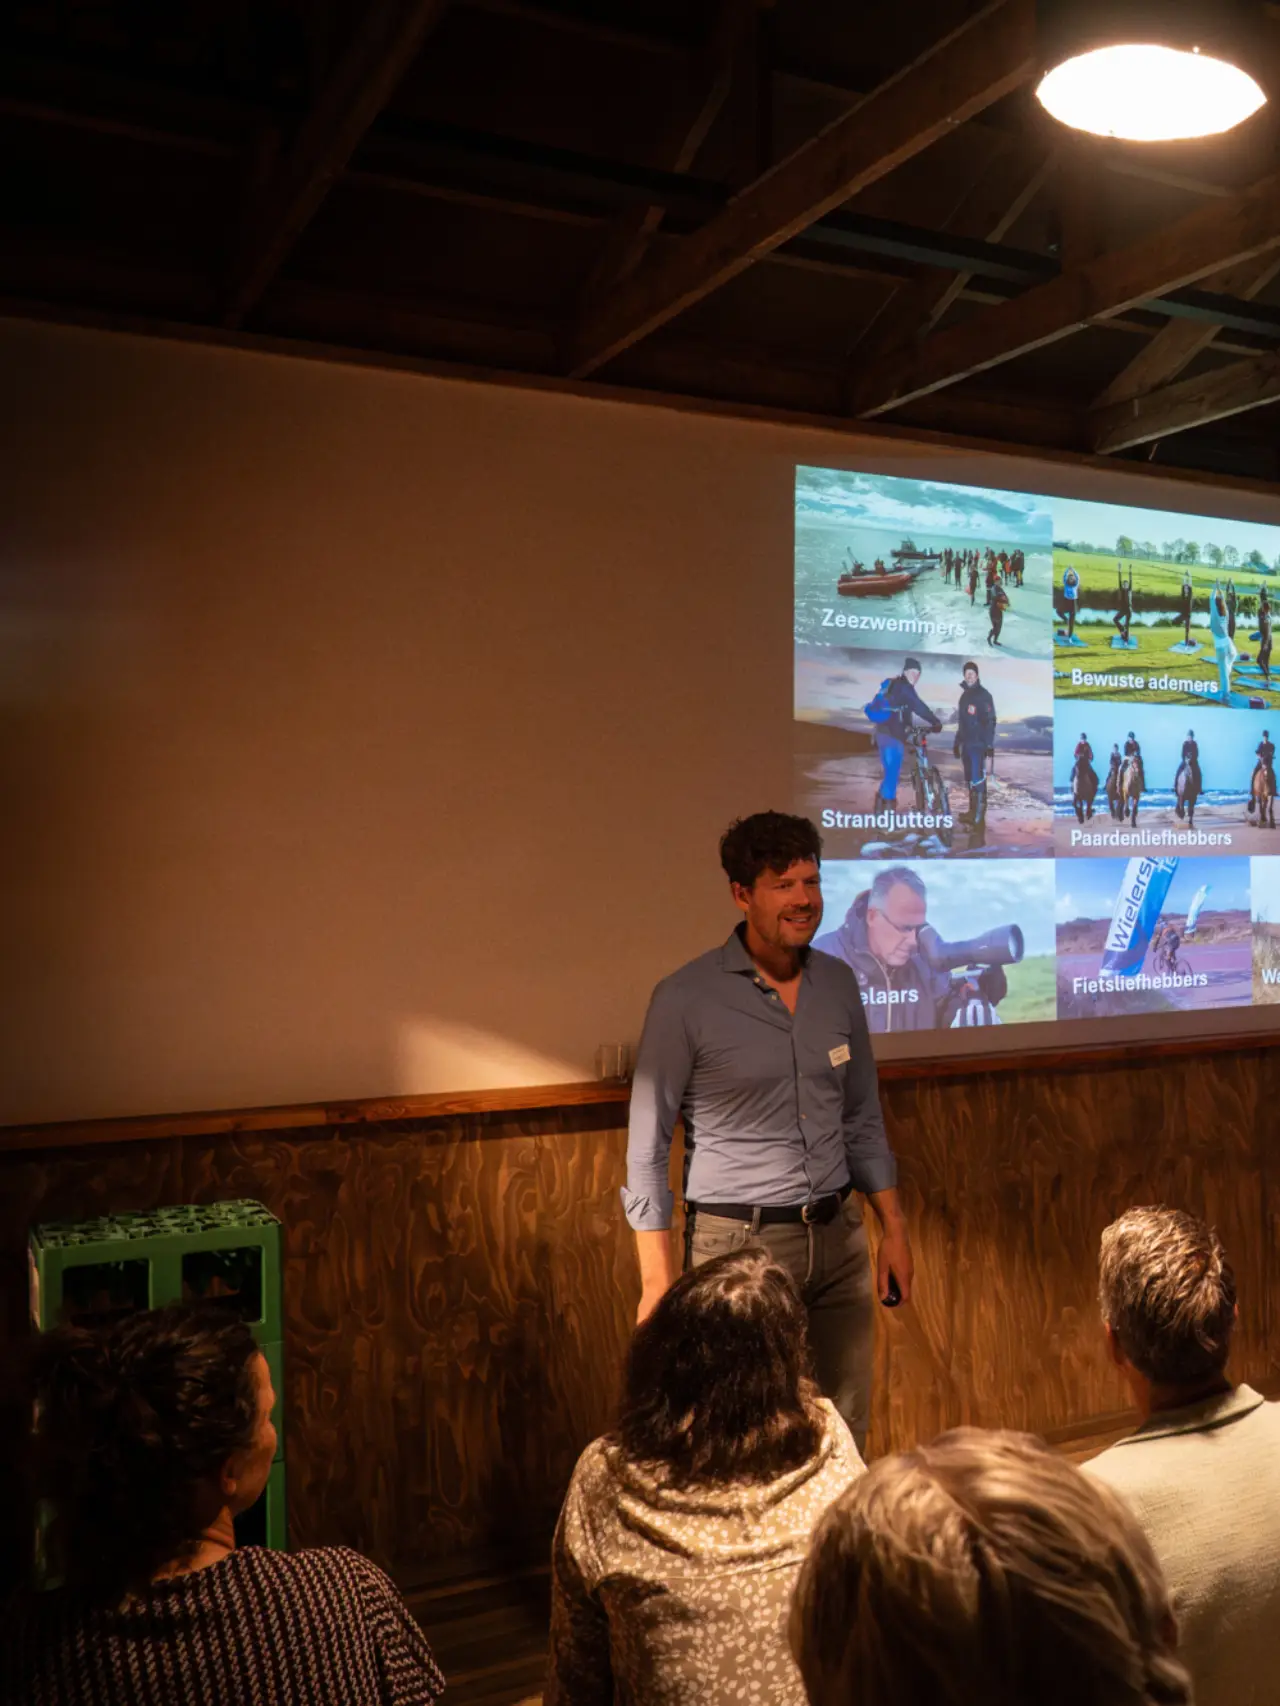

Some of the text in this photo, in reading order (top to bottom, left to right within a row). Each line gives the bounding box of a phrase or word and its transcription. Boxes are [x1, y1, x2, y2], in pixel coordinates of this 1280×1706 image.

[821, 608, 967, 637] Zeezwemmers
[1071, 668, 1219, 693] Bewuste ademers
[821, 809, 953, 832] Strandjutters
[1071, 829, 1232, 847] Paardenliefhebbers
[1073, 972, 1208, 994] Fietsliefhebbers
[860, 986, 919, 1005] elaars
